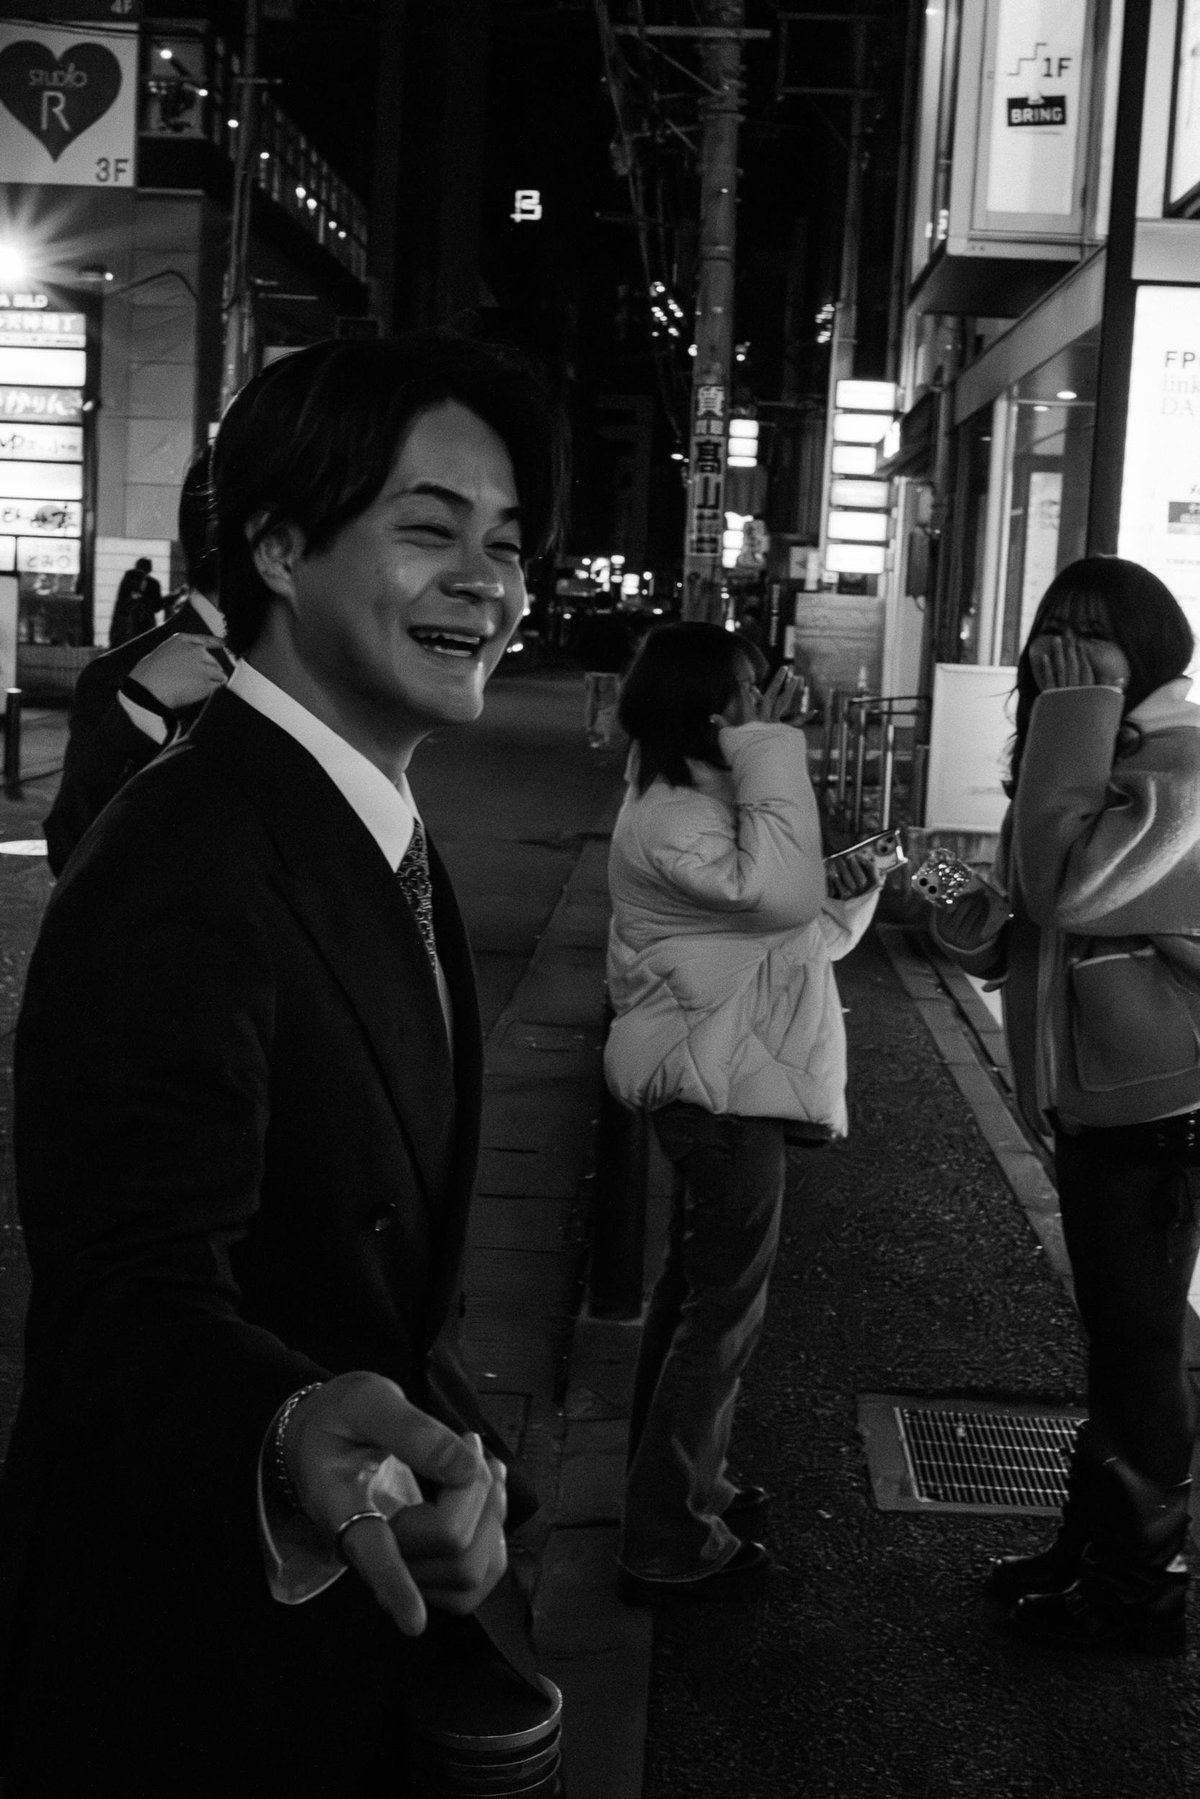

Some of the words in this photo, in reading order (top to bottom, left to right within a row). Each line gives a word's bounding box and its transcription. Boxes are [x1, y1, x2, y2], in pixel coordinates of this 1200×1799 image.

[1042, 56, 1071, 78] 1F
[39, 90, 71, 131] R
[1010, 106, 1063, 124] BRING
[95, 157, 130, 183] 3F
[1164, 350, 1200, 368] FP
